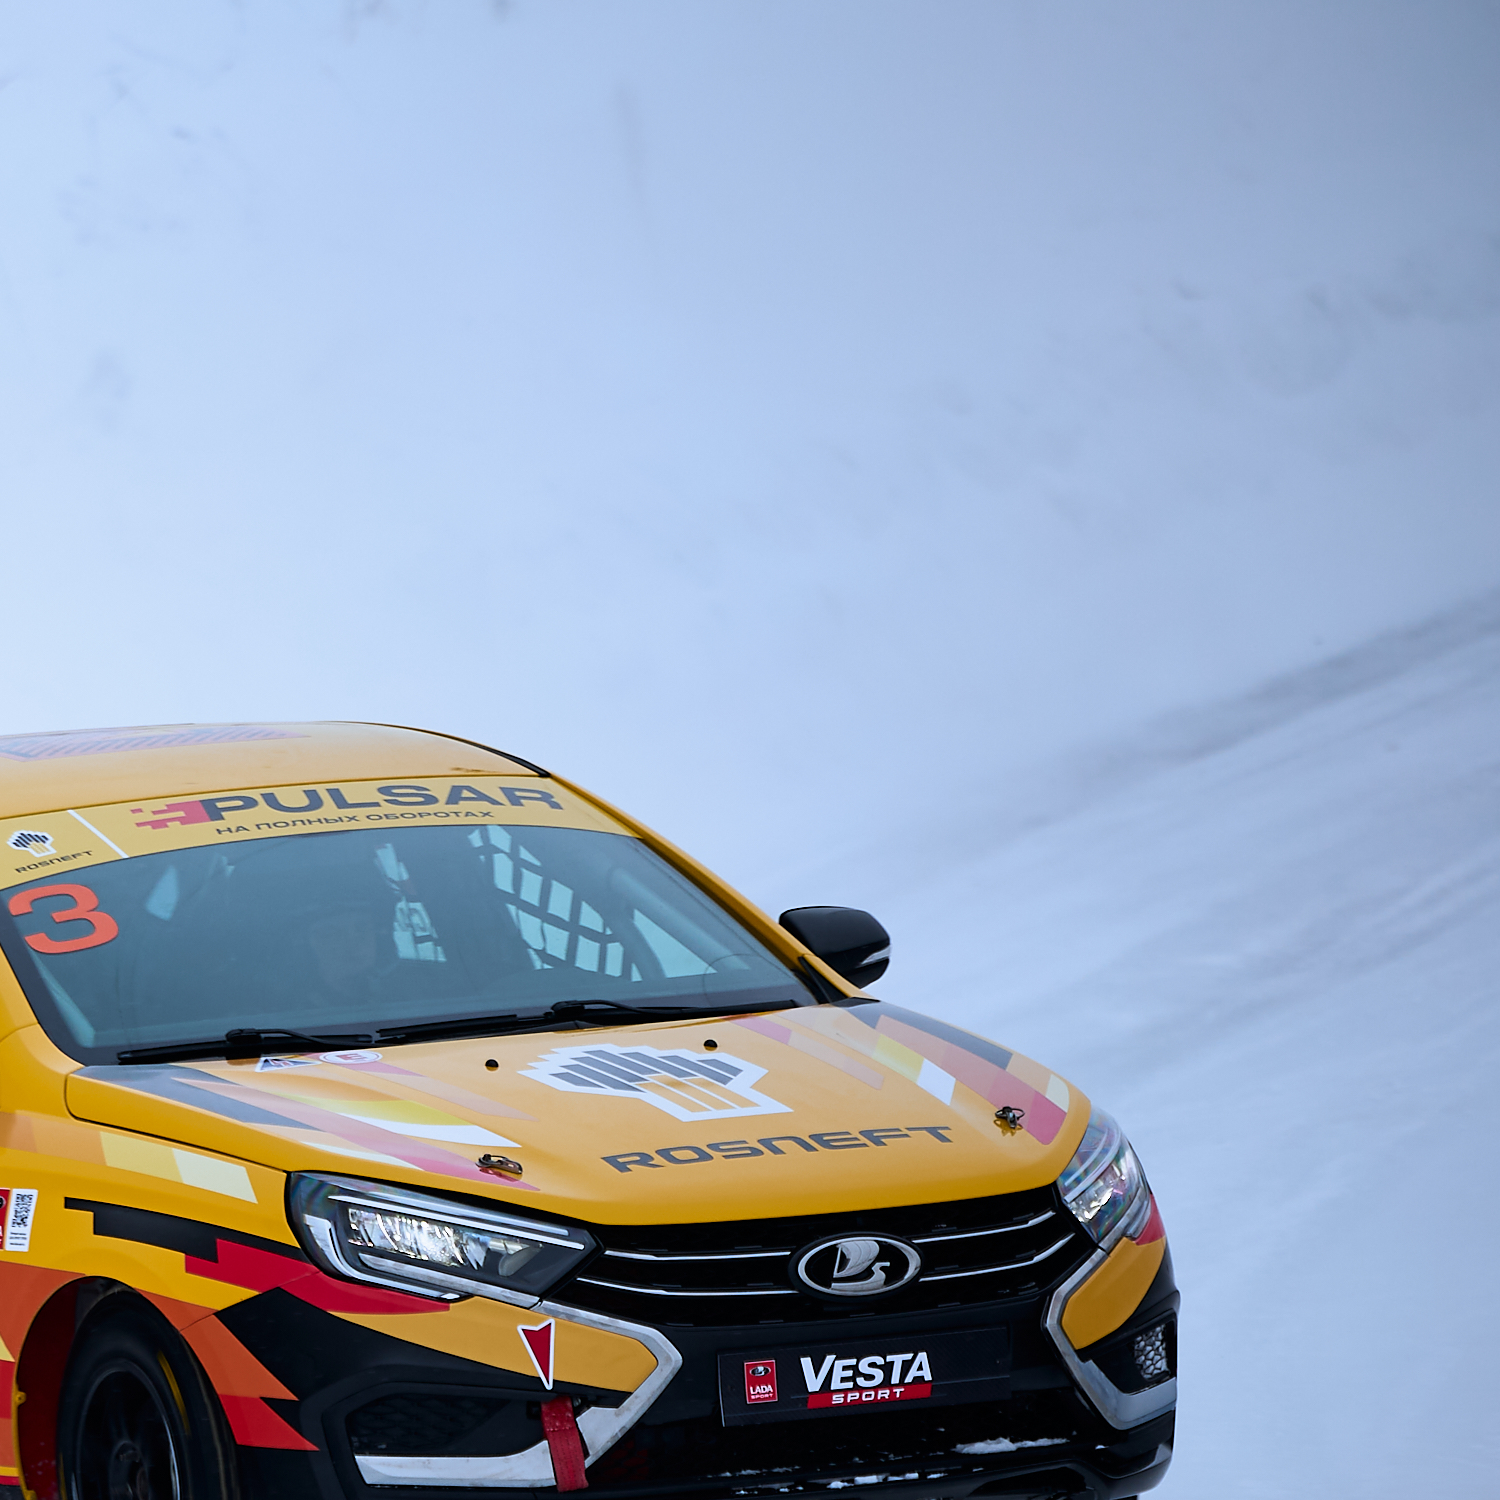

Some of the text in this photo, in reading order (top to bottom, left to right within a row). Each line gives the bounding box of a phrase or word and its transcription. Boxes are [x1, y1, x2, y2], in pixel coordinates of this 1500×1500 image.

[199, 785, 564, 821] PULSAR
[216, 811, 494, 835] НА ПОЛНЫХ ОБОРОТАХ
[15, 850, 93, 873] ROSNEFT
[7, 883, 119, 954] 3
[600, 1126, 952, 1174] ROSNEFT
[800, 1351, 933, 1392] VESTA
[750, 1384, 773, 1395] LADA
[831, 1388, 905, 1404] SPORT
